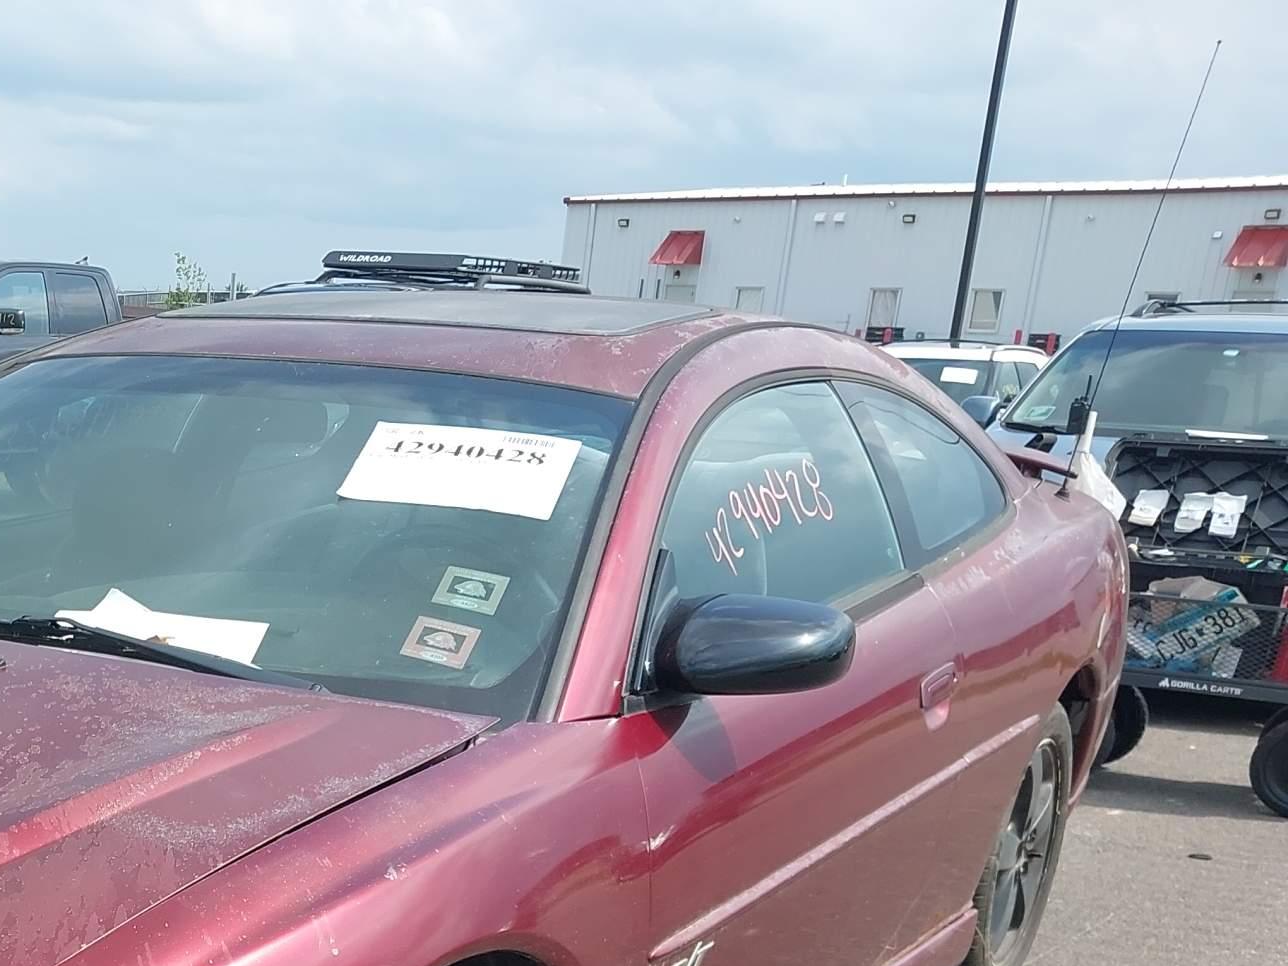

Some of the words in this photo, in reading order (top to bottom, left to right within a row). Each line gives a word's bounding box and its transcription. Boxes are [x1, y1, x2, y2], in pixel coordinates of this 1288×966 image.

[338, 253, 393, 264] WILDROAD
[385, 439, 548, 466] 42940428
[704, 457, 833, 577] 42940428
[1171, 680, 1208, 692] GORILLA
[1210, 685, 1242, 696] CARTS
